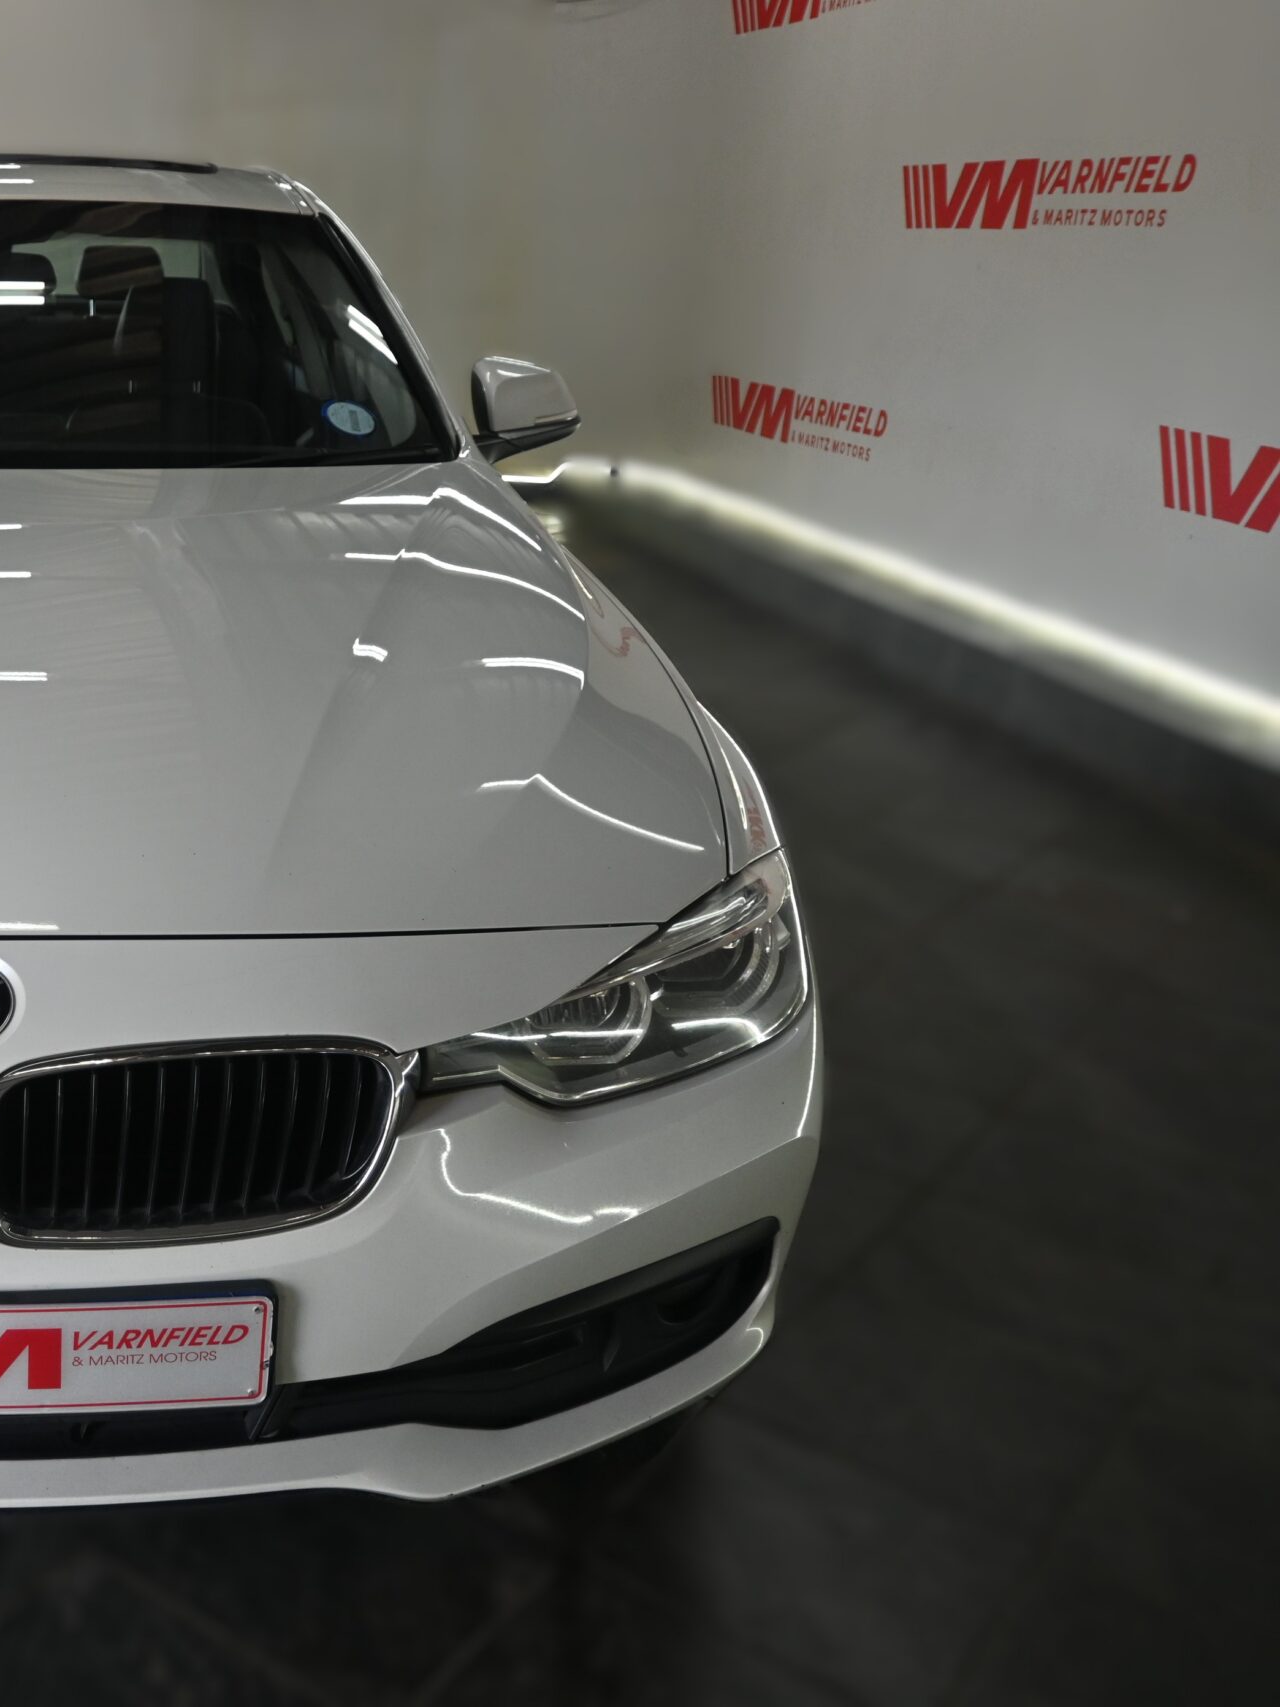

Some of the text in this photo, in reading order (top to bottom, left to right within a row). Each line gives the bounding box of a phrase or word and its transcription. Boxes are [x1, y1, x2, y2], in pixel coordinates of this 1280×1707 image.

[1036, 153, 1197, 195] VARNFIELD
[931, 157, 1040, 230] VM
[1032, 208, 1168, 228] & MARITZ MOTORS
[730, 377, 796, 444] VM
[794, 393, 888, 438] VARNFIELD
[798, 431, 830, 452] MARITZ
[832, 439, 872, 462] MOTORS
[72, 1324, 249, 1351] VARNFIELD
[72, 1350, 217, 1367] & MARITZ MOTORS
